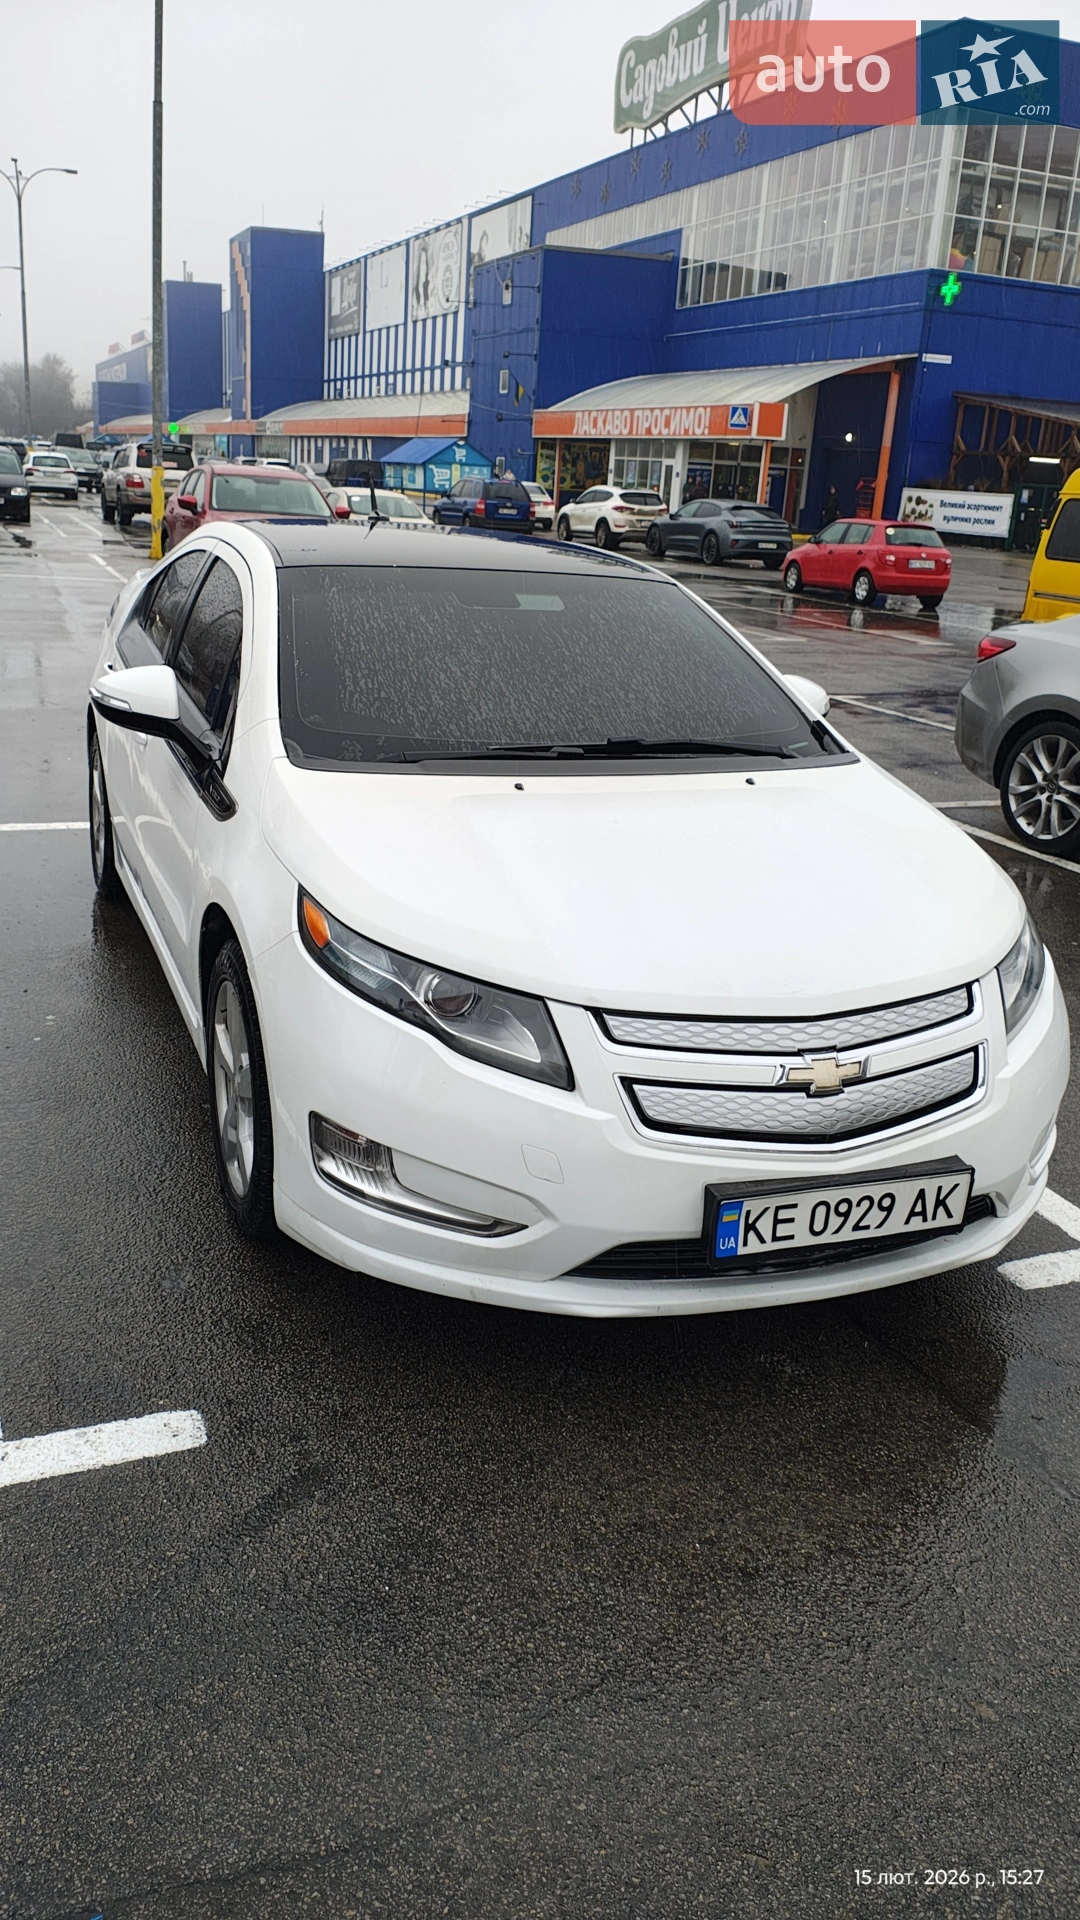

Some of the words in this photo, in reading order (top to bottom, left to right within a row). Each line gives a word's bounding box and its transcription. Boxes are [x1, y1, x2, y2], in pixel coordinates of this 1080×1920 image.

[620, 18, 708, 119] Садовий
[573, 410, 631, 435] ЛАСКАВО
[632, 407, 711, 435] ПРОСИМО!
[939, 499, 966, 510] Великий
[972, 518, 995, 526] рослин
[742, 1203, 798, 1247] KE
[808, 1192, 896, 1237] 0929
[904, 1183, 961, 1225] AK
[719, 1236, 736, 1250] UA
